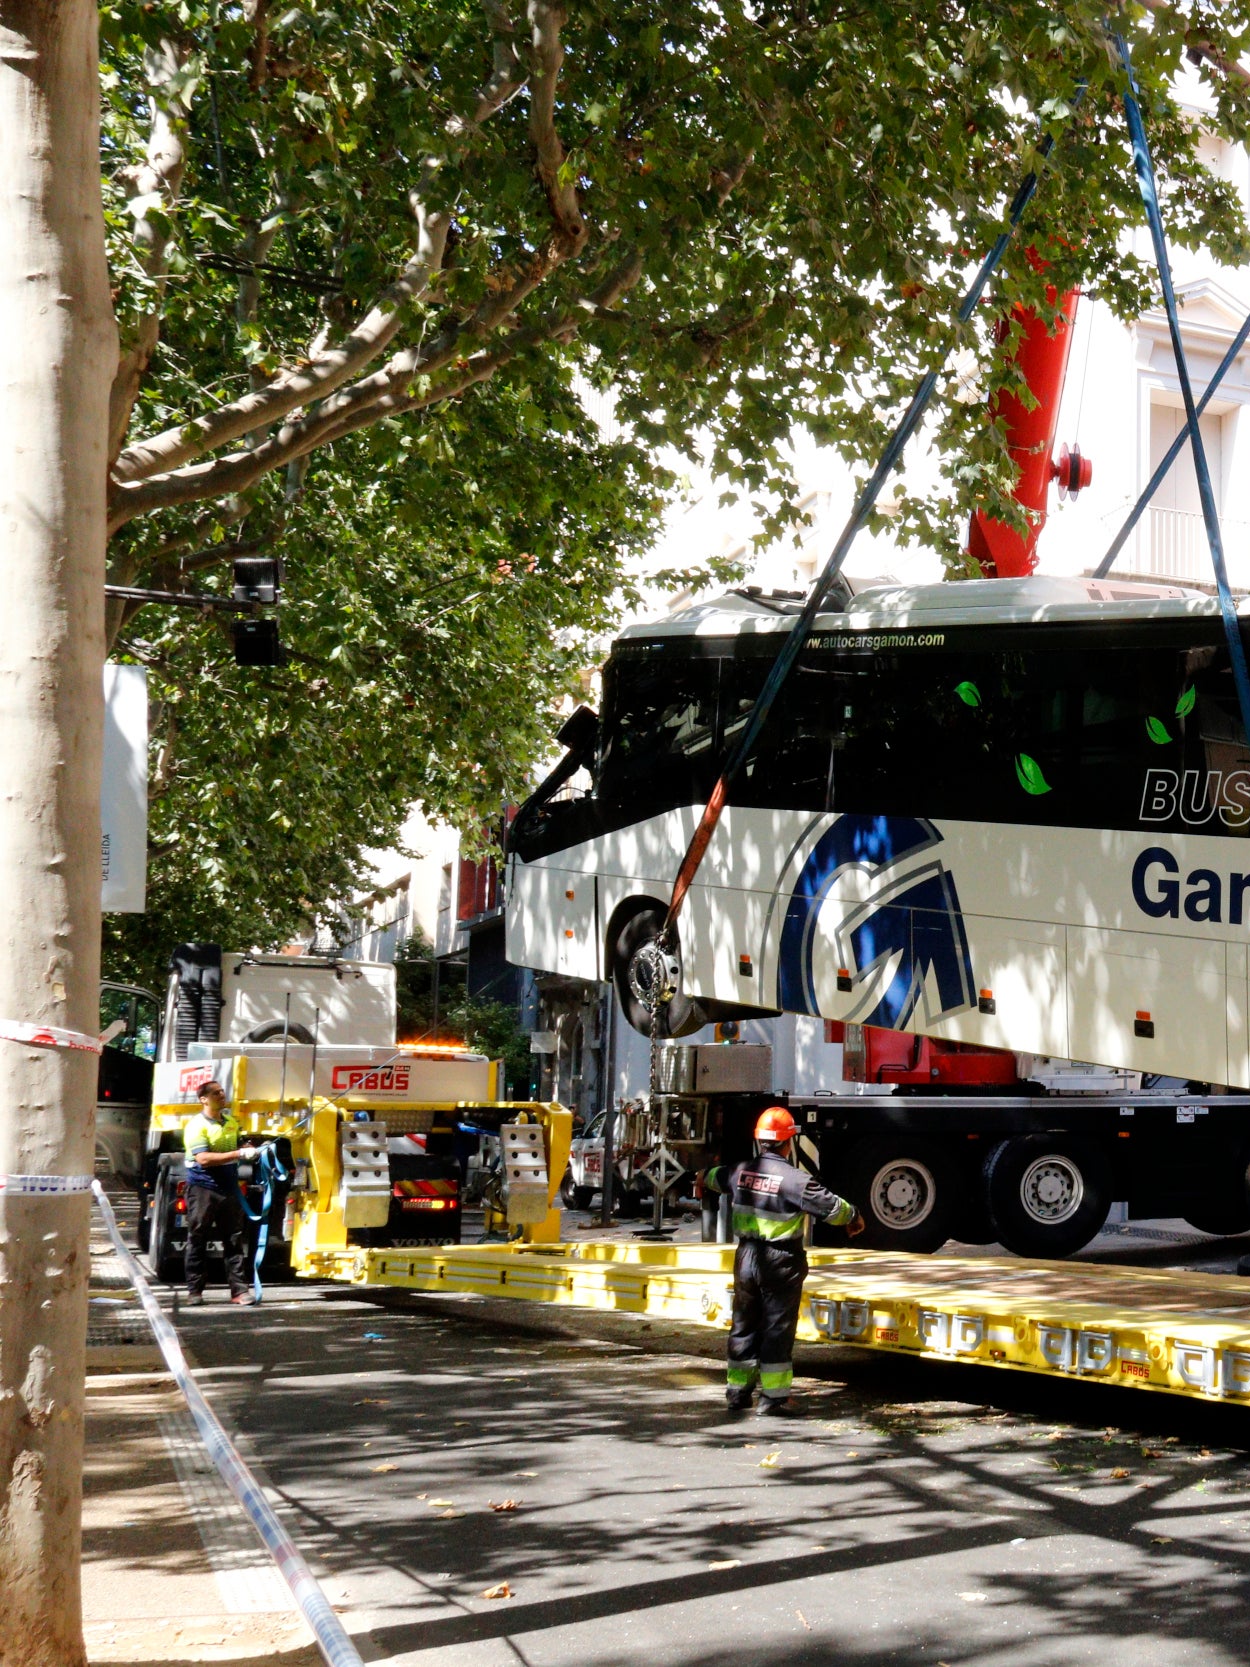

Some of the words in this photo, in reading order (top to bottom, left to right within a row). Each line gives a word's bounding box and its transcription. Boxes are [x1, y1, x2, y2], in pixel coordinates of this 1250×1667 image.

[806, 633, 945, 651] w.autocarsgamon.com
[101, 834, 111, 867] LLEIDA
[391, 1238, 455, 1248] VOLVO
